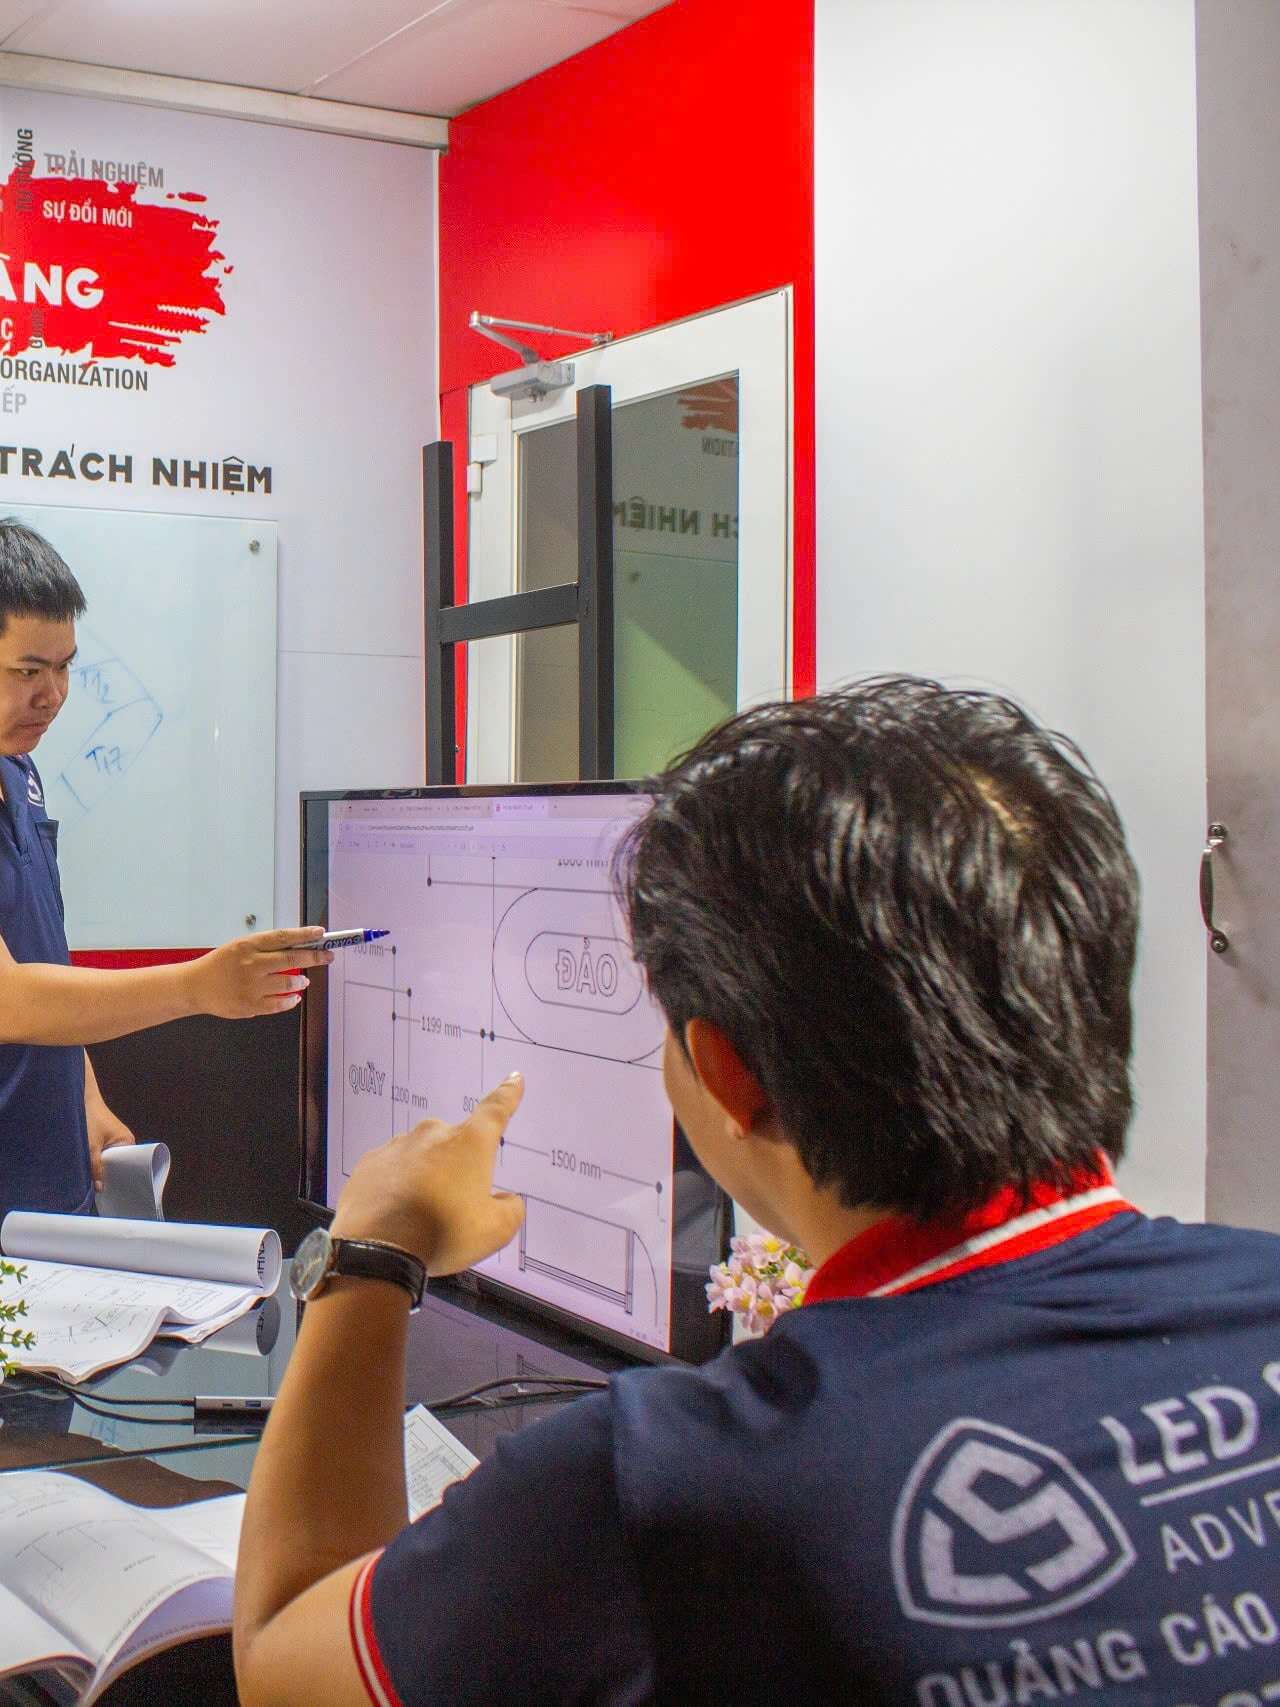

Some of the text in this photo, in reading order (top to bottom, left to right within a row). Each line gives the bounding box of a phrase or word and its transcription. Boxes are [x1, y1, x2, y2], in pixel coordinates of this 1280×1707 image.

[44, 150, 164, 189] TRẢI NGHIỆM
[43, 198, 133, 228] SỰ ĐỔI MỚI
[0, 357, 149, 392] ORGANIZATION
[152, 455, 273, 495] NHIỆM
[555, 936, 618, 998] ĐẢO
[421, 1016, 463, 1039] 1199 mm
[462, 1095, 481, 1113] 80
[551, 1149, 602, 1180] 1500 mm
[1099, 1385, 1260, 1484] LED
